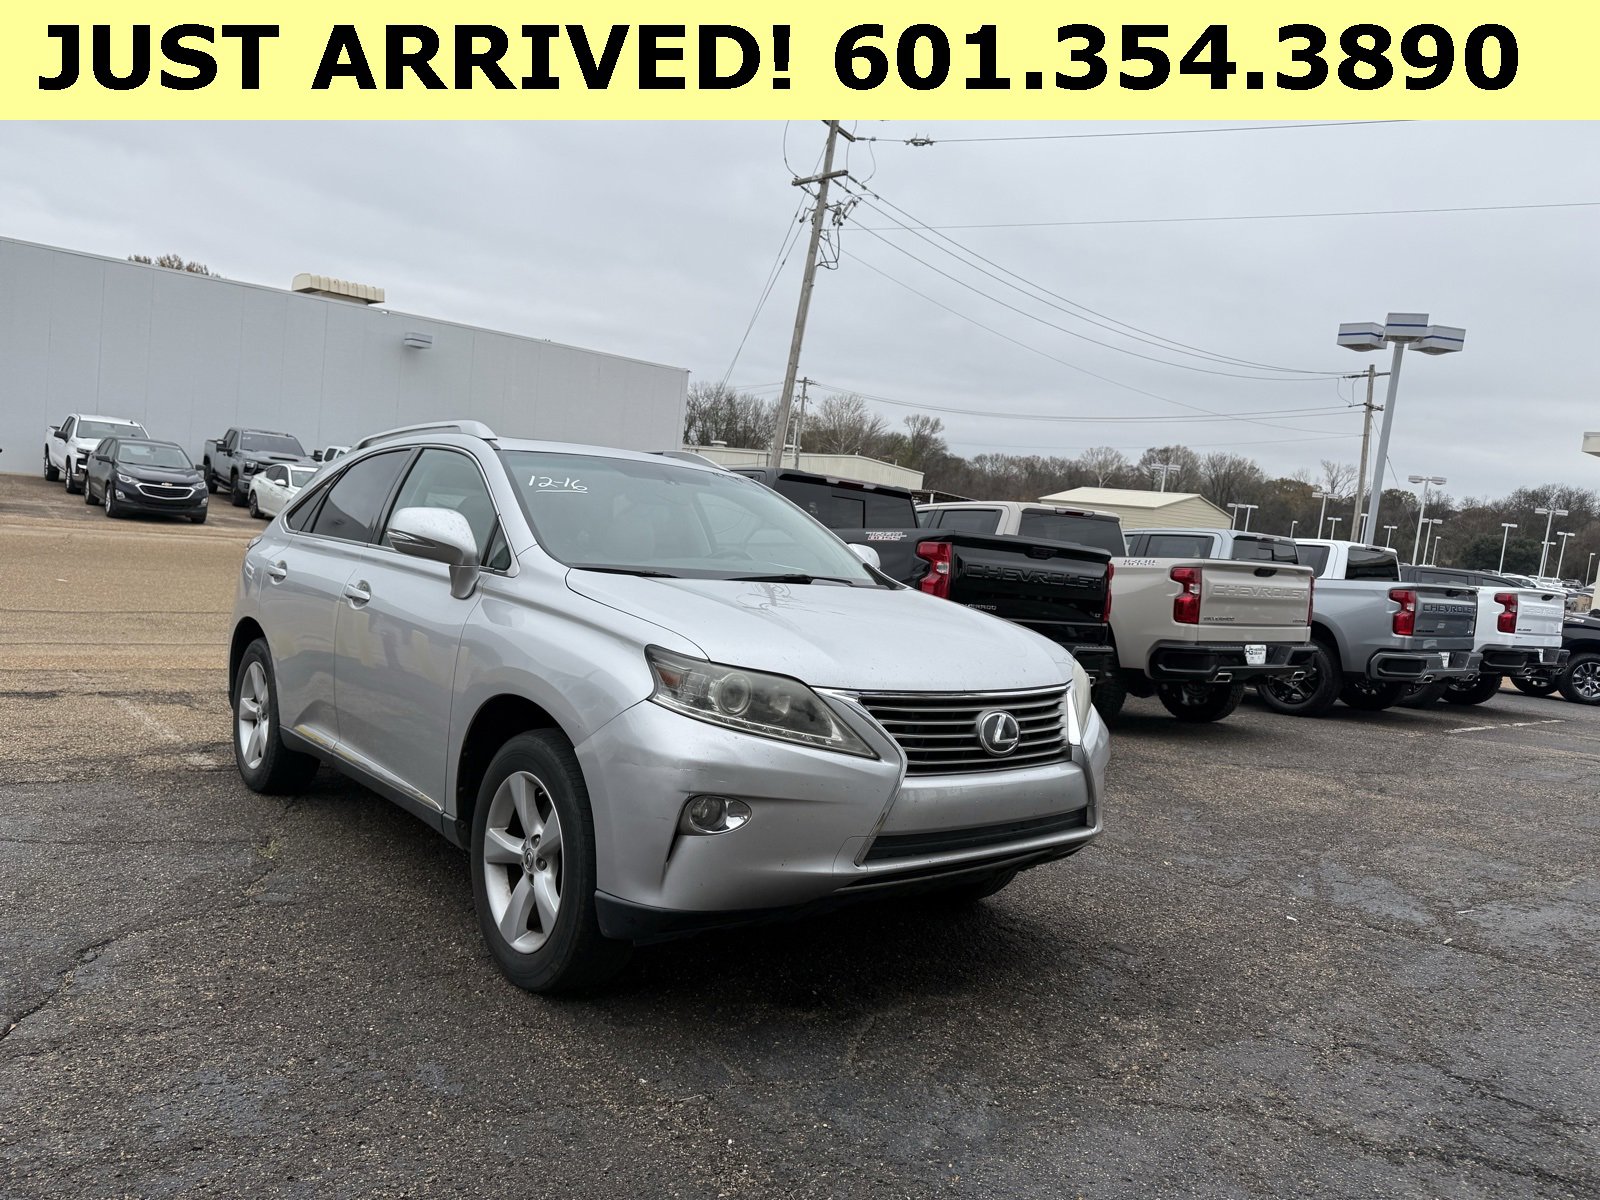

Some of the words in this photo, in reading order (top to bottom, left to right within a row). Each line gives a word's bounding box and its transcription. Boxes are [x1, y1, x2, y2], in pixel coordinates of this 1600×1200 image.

[528, 475, 588, 491] 12-16
[966, 563, 1101, 589] CHEVROLET
[1211, 584, 1308, 600] CHEVROLET
